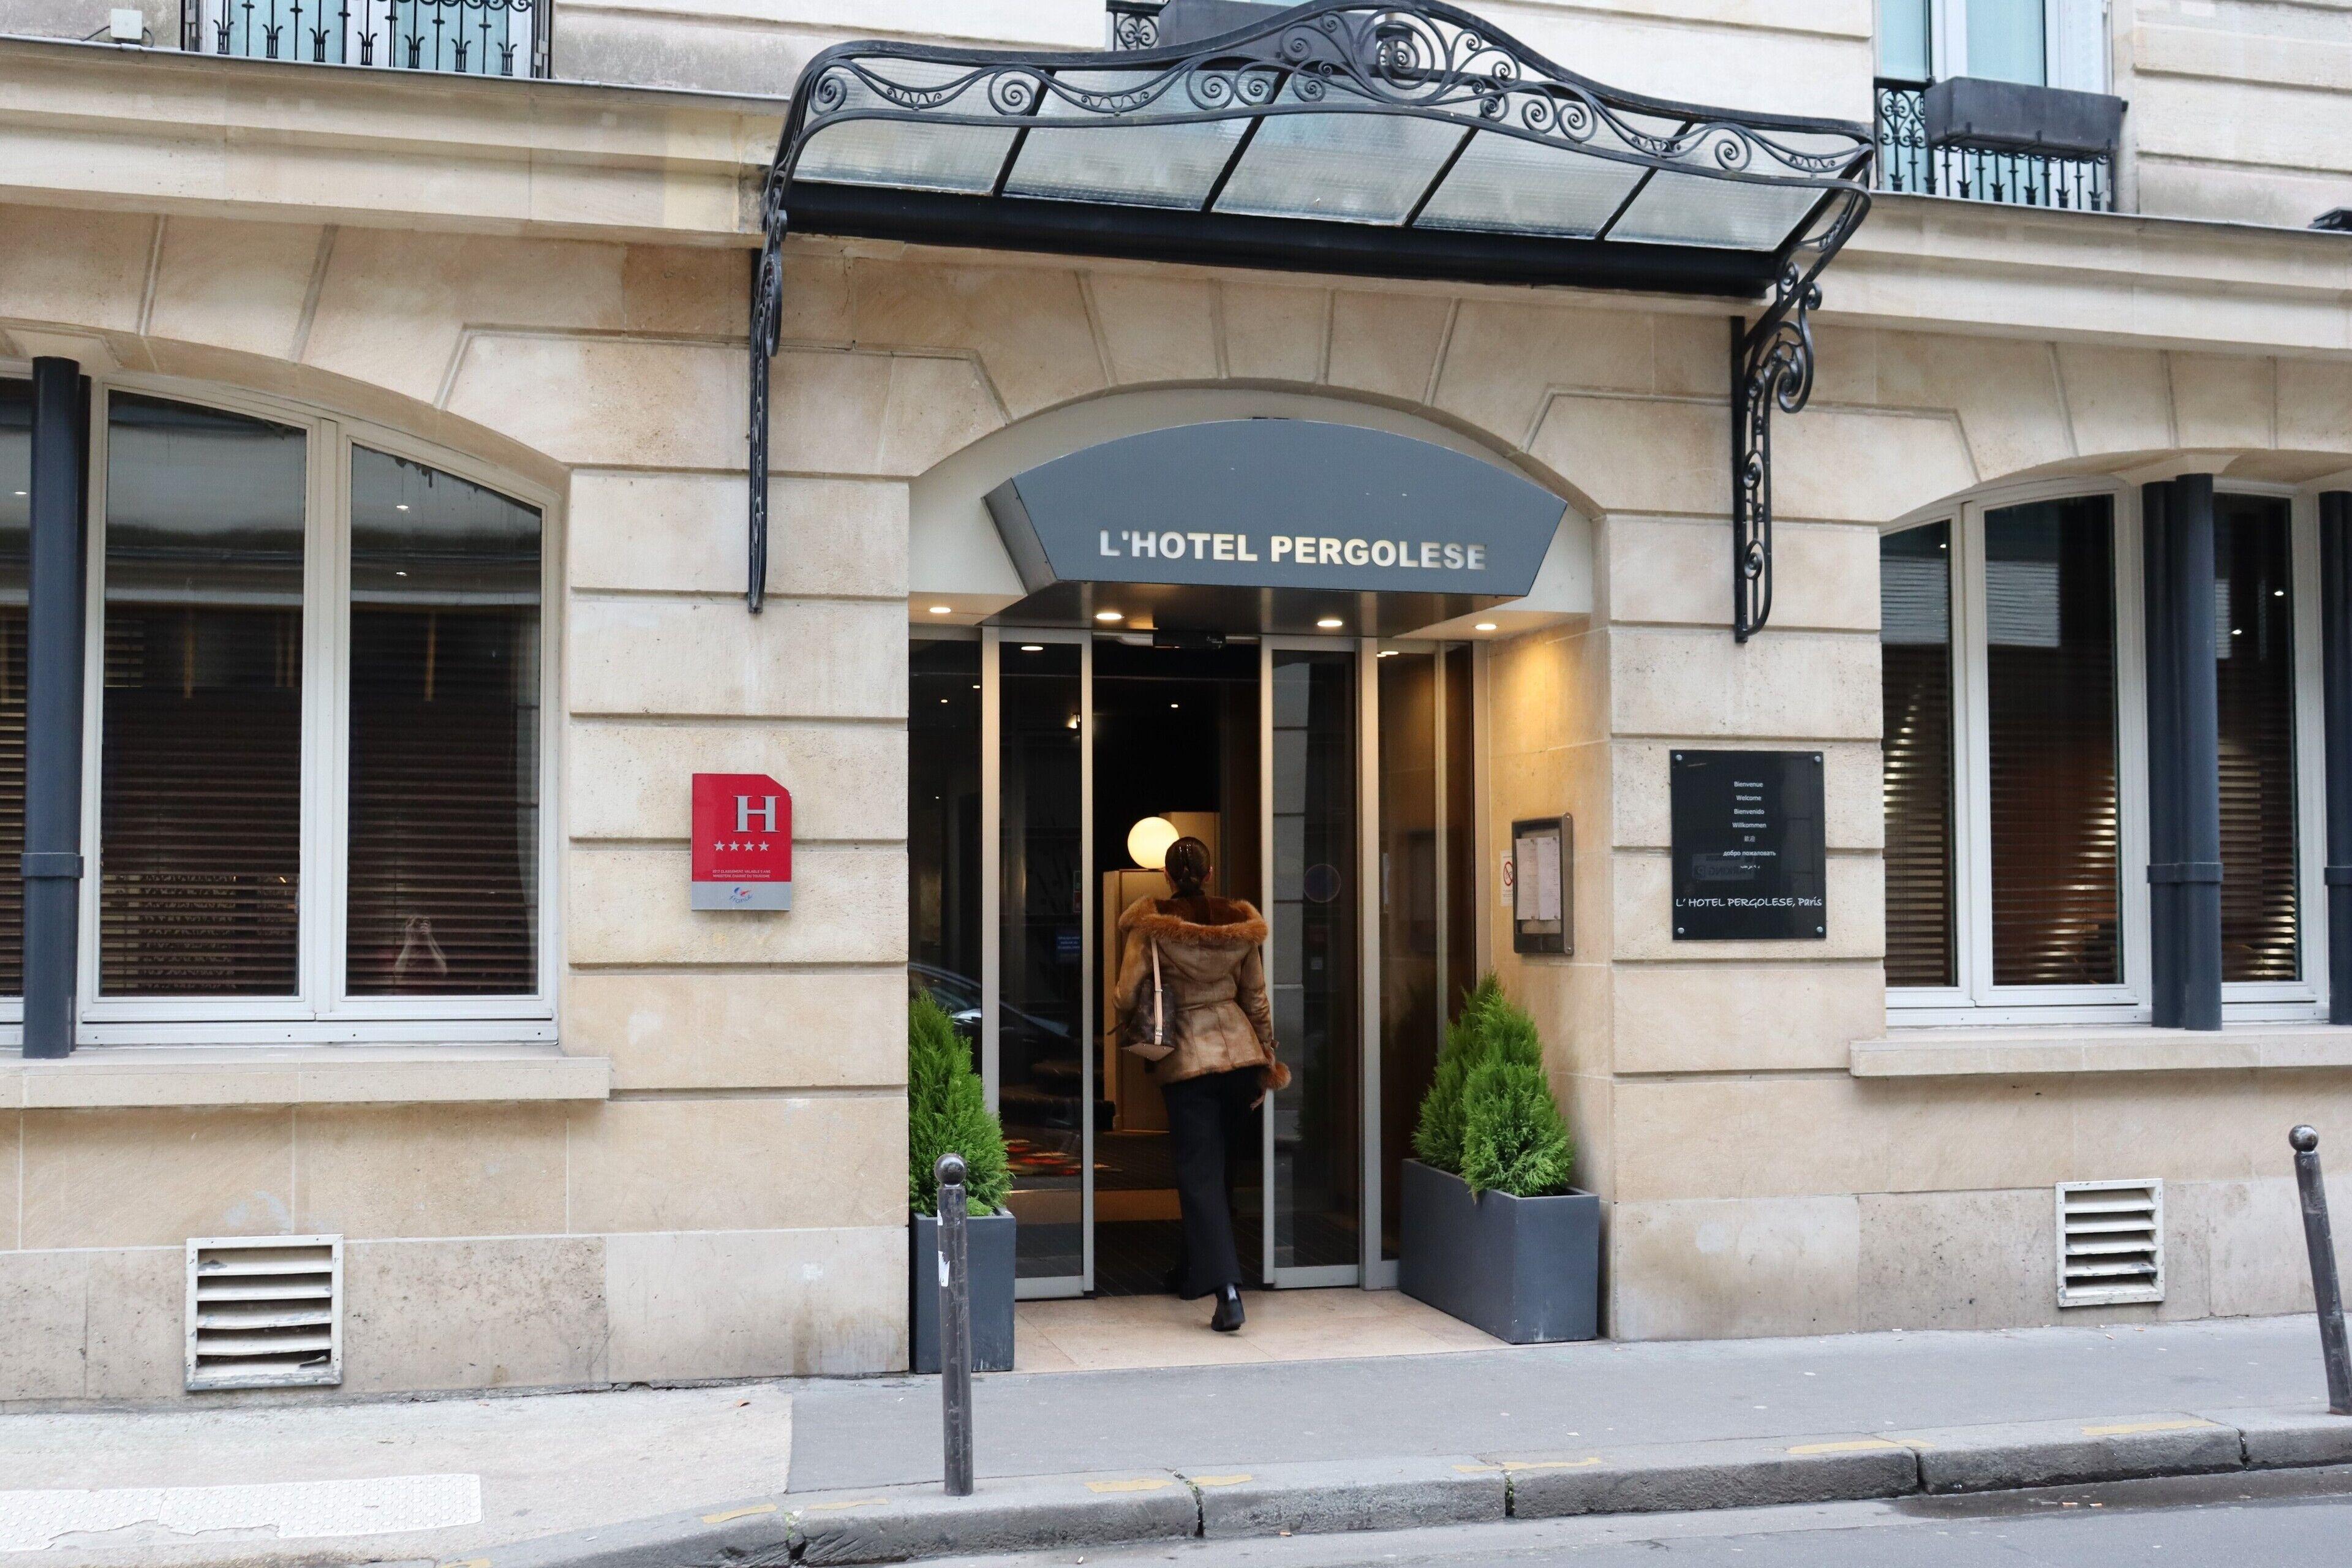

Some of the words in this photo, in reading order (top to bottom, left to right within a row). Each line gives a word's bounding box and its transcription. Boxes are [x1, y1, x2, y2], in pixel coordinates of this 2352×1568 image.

[1100, 530, 1258, 562] L'HOTEL
[1270, 535, 1487, 570] PERGOLESE
[733, 795, 780, 832] H
[1689, 898, 1726, 907] HOTEL
[1727, 898, 1795, 909] PERGOLESE,
[1798, 896, 1822, 907] Paris
